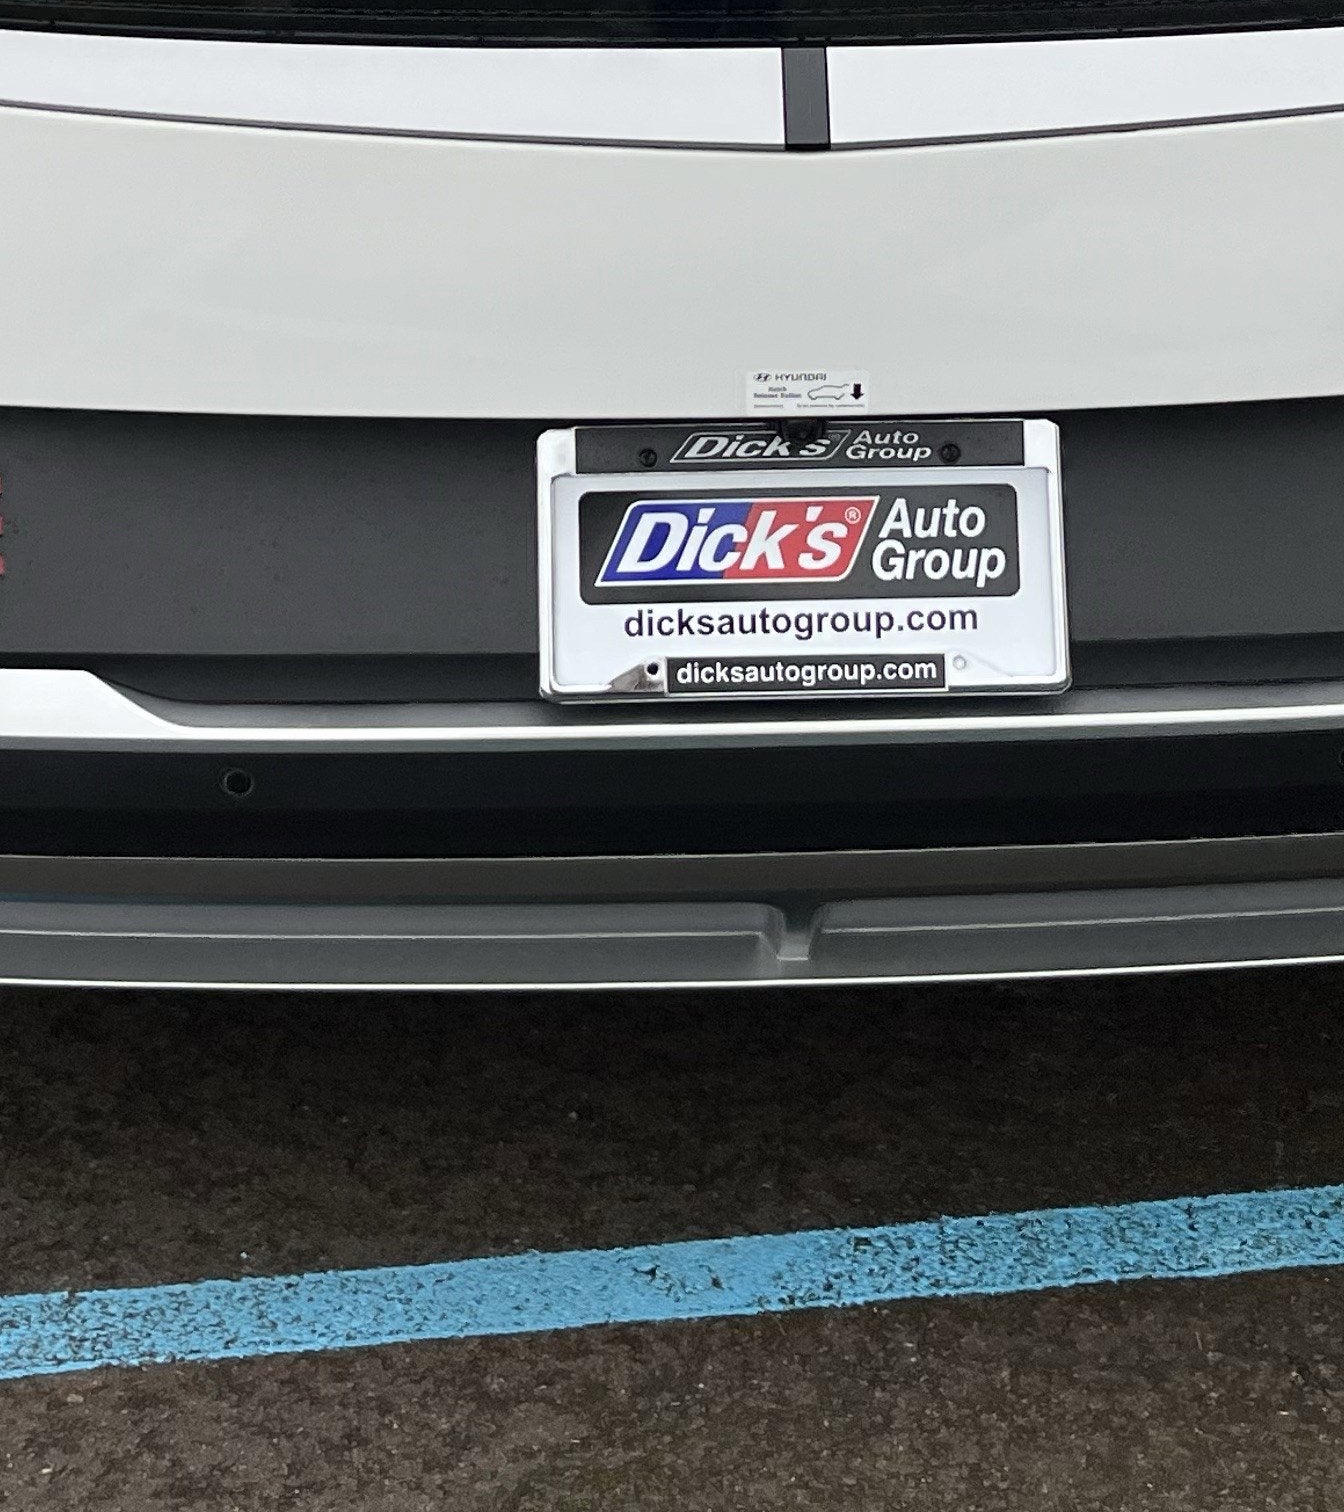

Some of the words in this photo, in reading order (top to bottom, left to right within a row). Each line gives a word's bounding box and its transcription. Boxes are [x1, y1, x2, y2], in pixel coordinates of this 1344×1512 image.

[775, 373, 827, 381] HYUNDAI
[684, 434, 831, 458] Dicks
[852, 429, 920, 445] Auto
[845, 443, 932, 462] Group
[878, 497, 987, 540] Auto
[615, 506, 849, 574] Dick's
[871, 539, 1007, 588] Group
[623, 607, 979, 641] dicksautogroup.com
[676, 659, 939, 687] dicksautogroup.com
